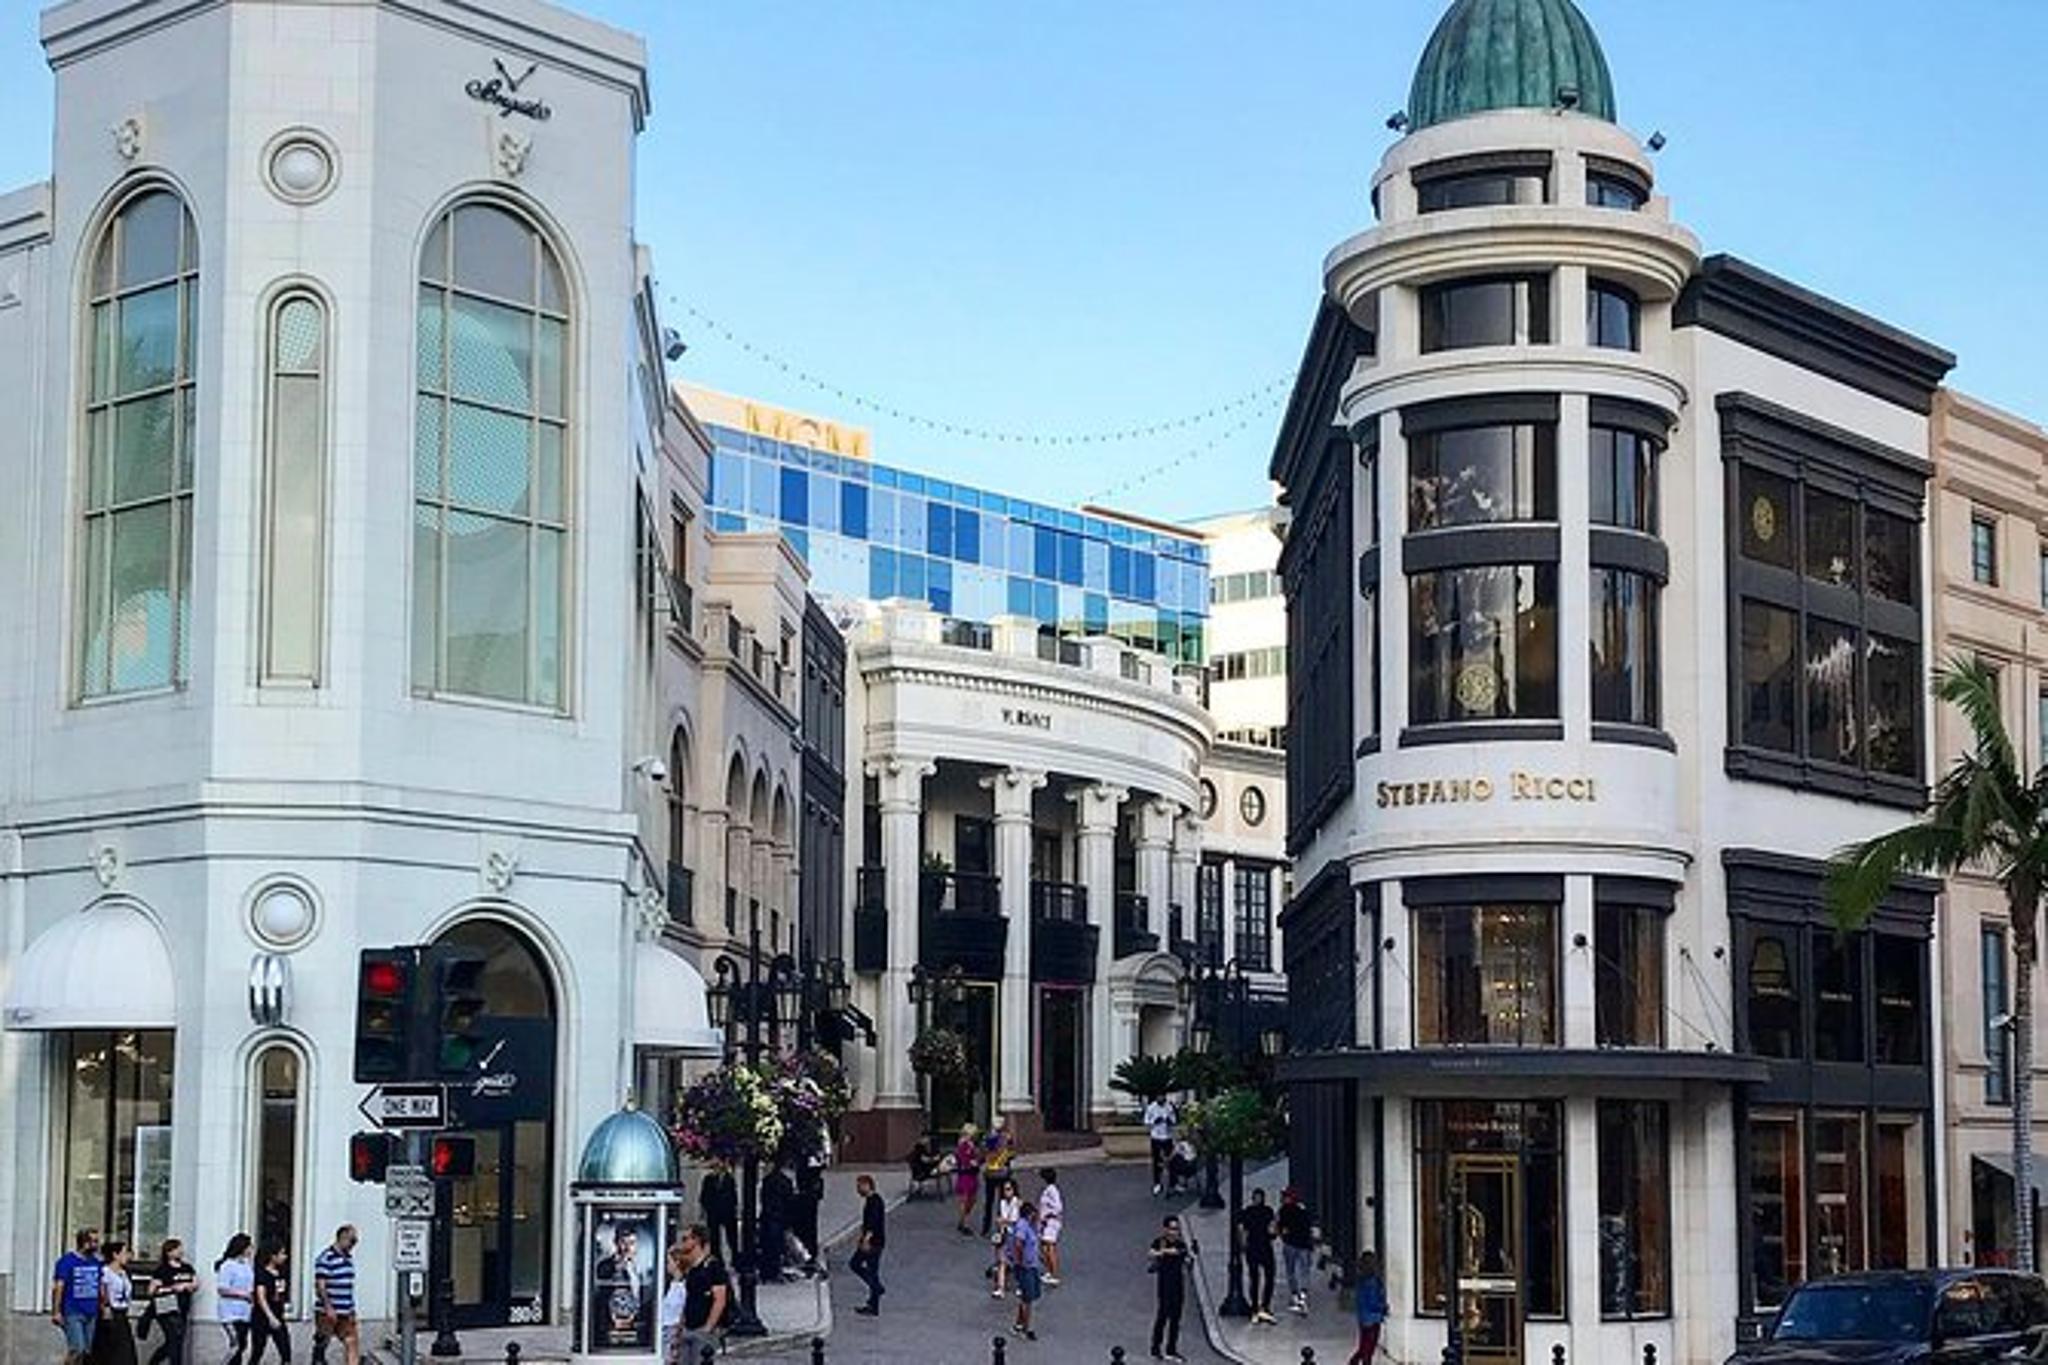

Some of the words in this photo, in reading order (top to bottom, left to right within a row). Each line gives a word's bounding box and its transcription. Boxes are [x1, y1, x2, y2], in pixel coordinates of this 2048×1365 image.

[1377, 777, 1493, 808] STEFANO
[1511, 772, 1597, 801] RICCI
[383, 1098, 407, 1114] ONE
[411, 1098, 434, 1114] WAY
